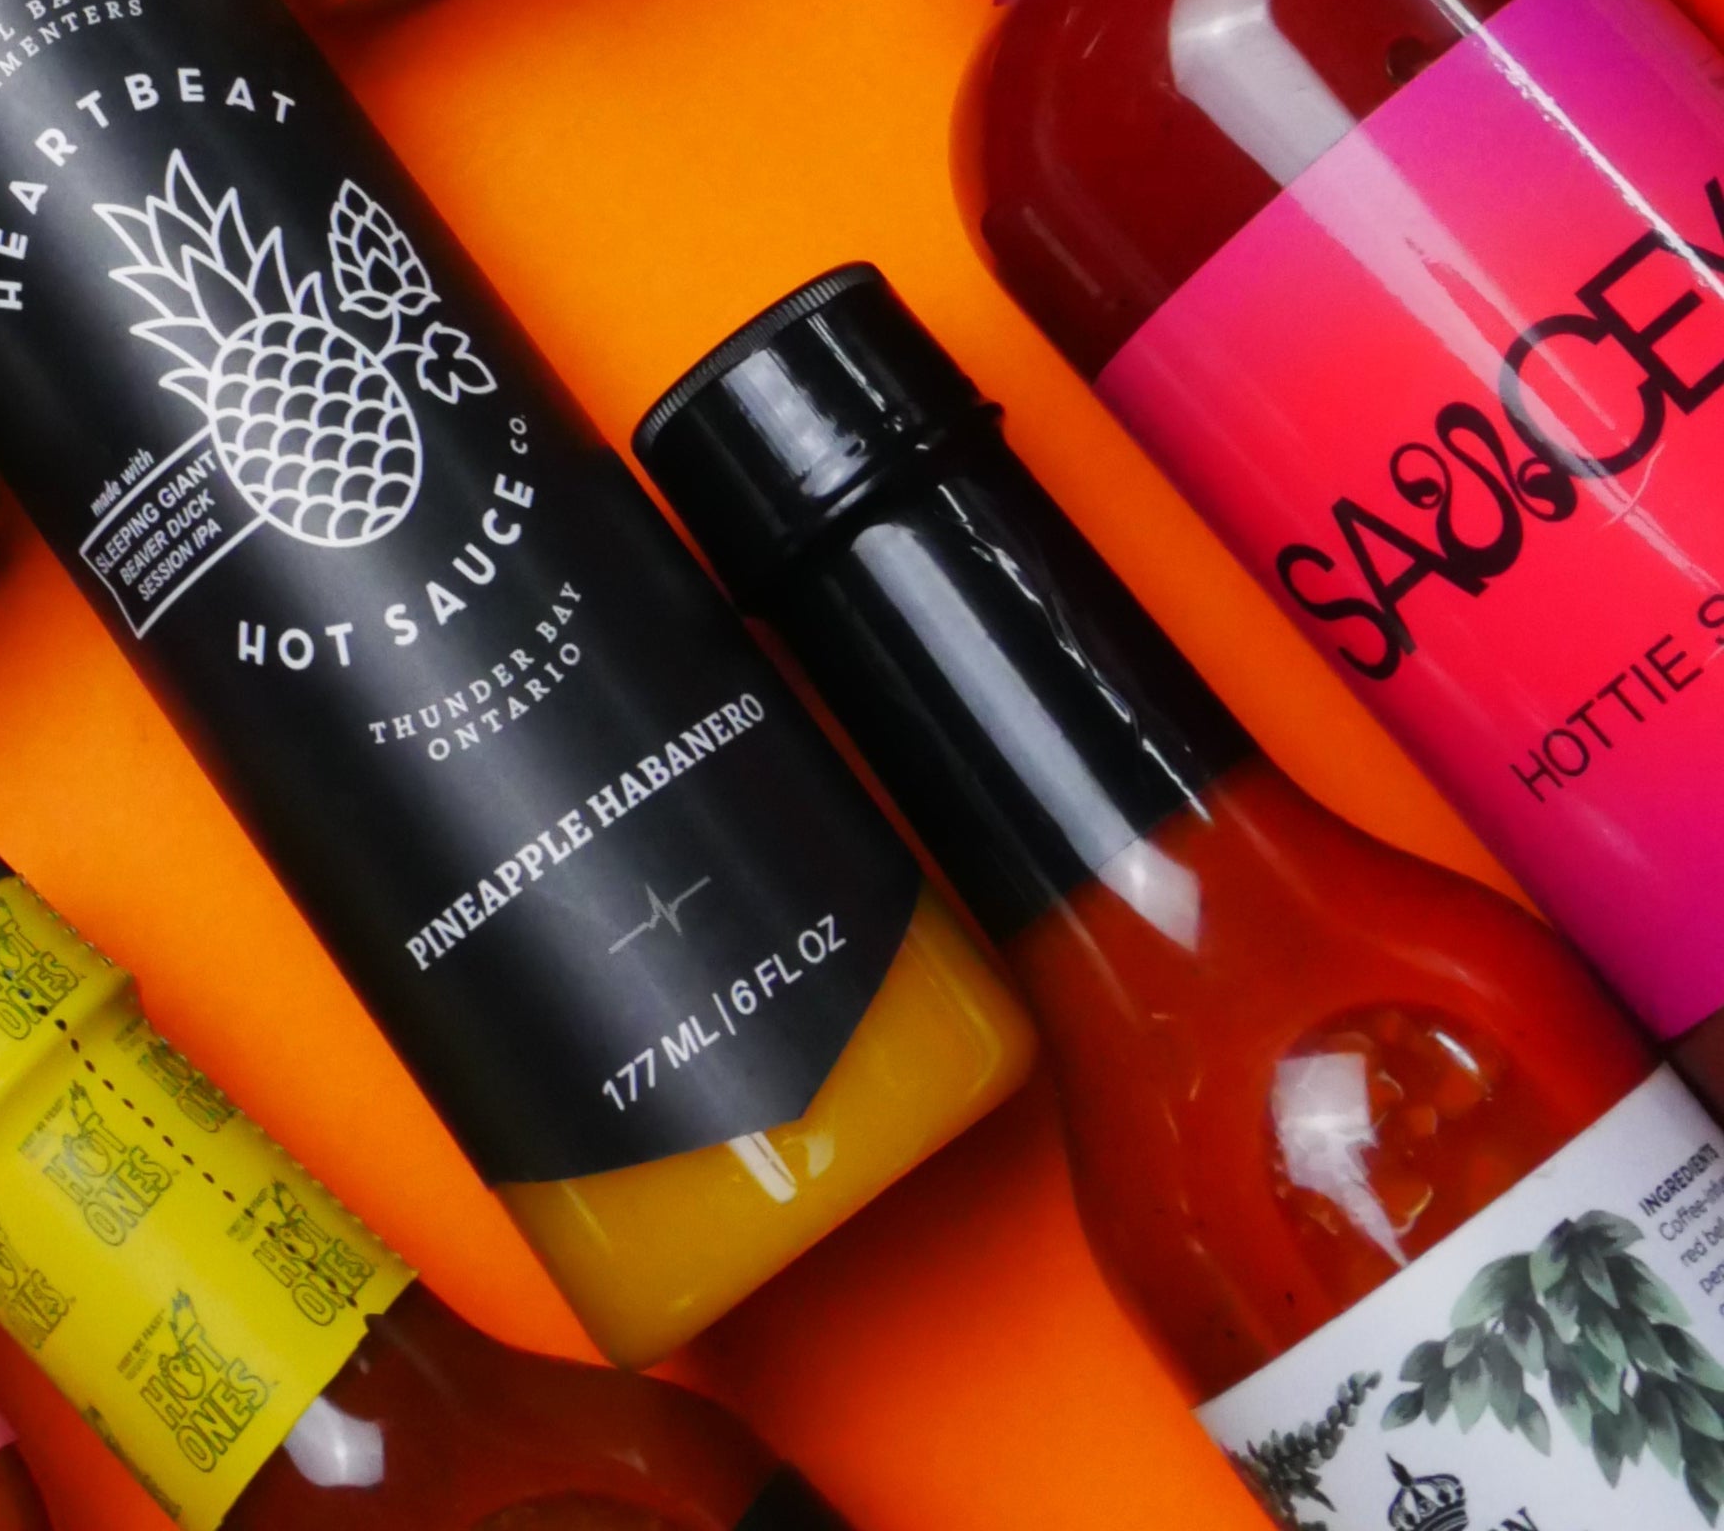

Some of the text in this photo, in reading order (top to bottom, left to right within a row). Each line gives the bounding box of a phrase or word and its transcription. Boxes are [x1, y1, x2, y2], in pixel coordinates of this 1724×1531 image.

[90, 447, 155, 519] made with
[95, 450, 220, 575] SLEEPING GIANT
[120, 488, 216, 587] BEAVER DUCK
[138, 541, 196, 603] SESSION
[237, 472, 536, 670] HOT SAUCE
[368, 581, 584, 745] THUNDER BAY
[427, 641, 582, 762] ONTARIO
[1510, 634, 1704, 804] HOTTIE
[405, 692, 766, 971] PINEAPPLE HABANERO
[602, 913, 847, 1111] 177 ML FL OZ
[176, 1360, 269, 1472] ONES
